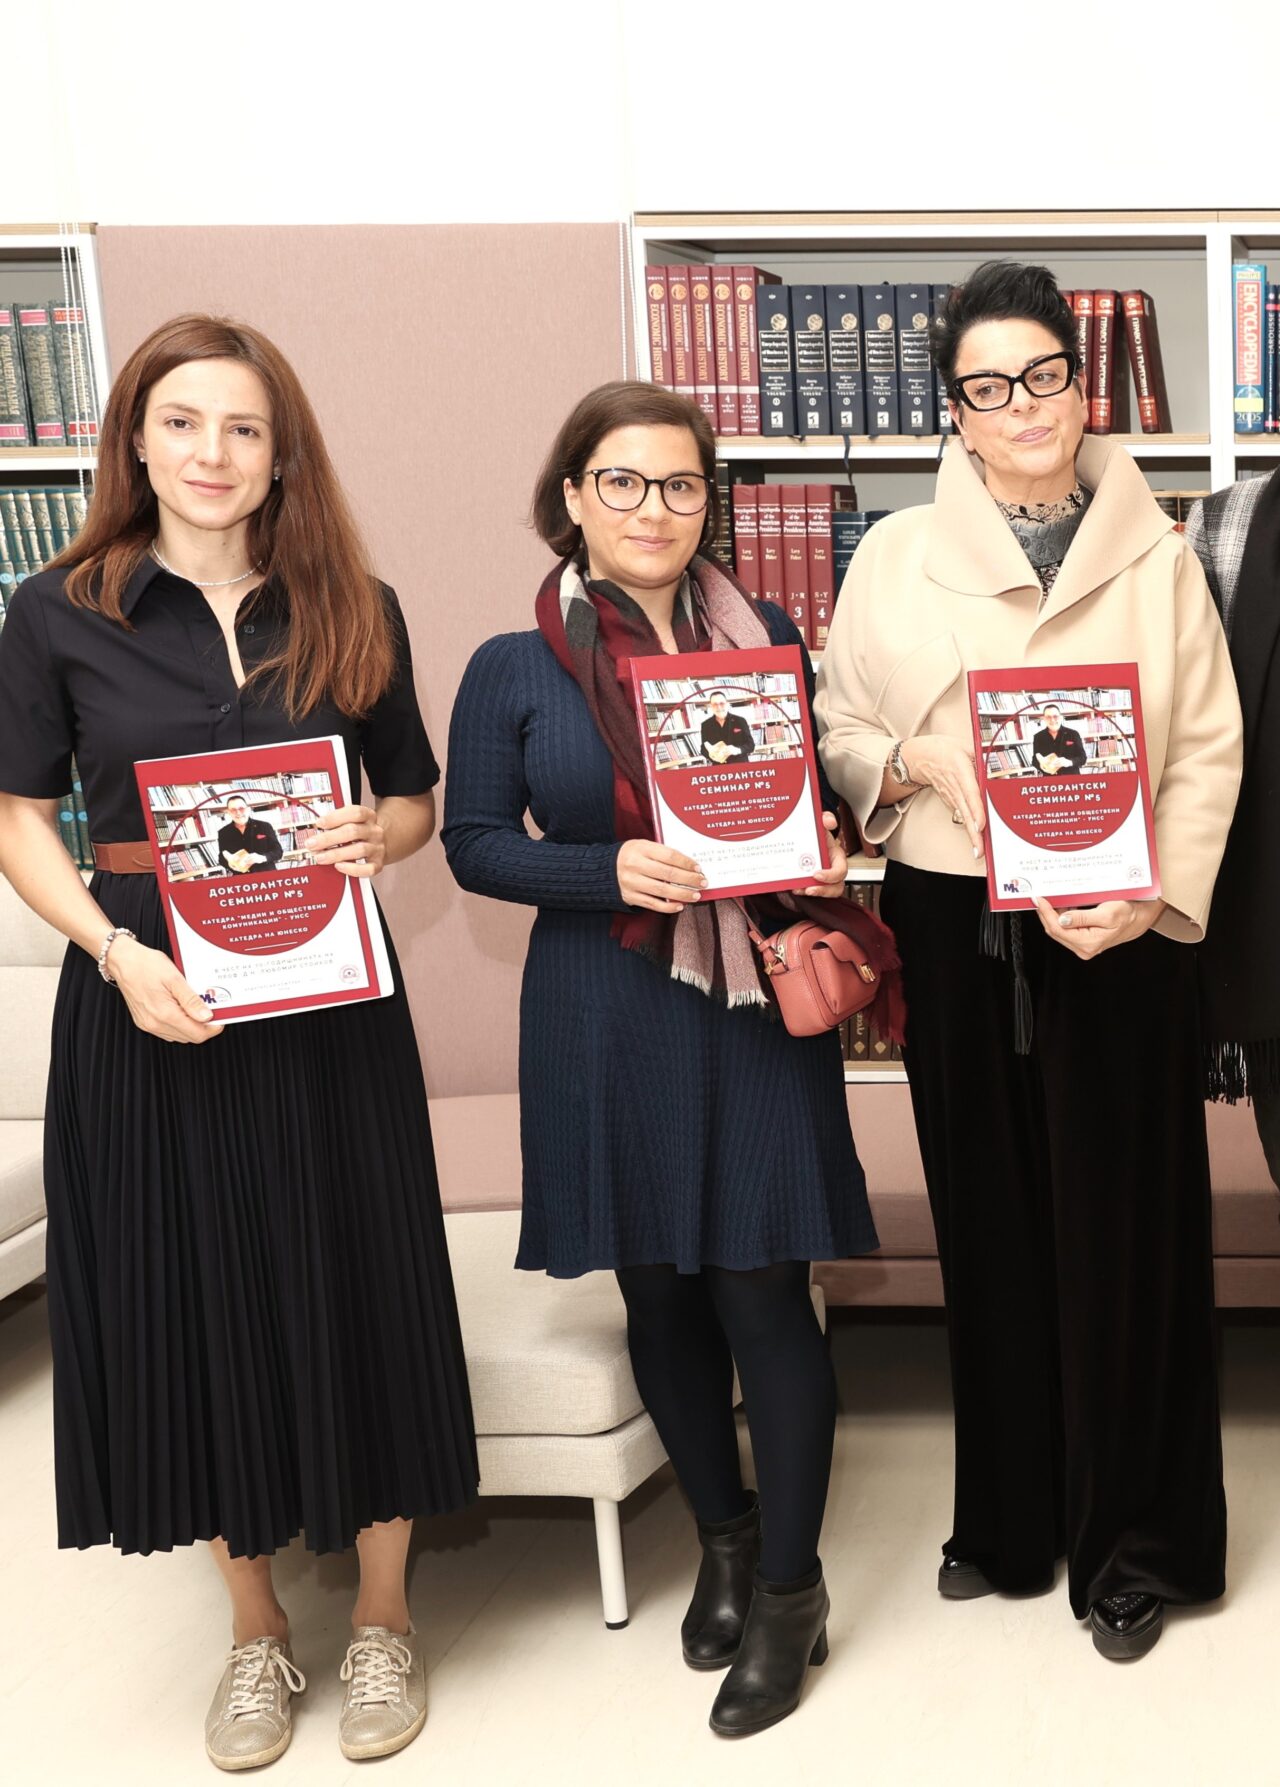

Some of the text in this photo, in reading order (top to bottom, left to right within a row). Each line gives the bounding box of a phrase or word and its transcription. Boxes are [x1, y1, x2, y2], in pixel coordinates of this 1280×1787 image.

[650, 304, 662, 346] ECONOMIC
[1100, 317, 1108, 343] ПРАВО
[1132, 317, 1141, 344] ПРАВО
[1243, 284, 1258, 382] ENCYCLOPEDIA
[673, 304, 686, 382] ECONOMIC HISTORY
[694, 304, 708, 382] ECONOMIC HISTORY
[715, 304, 728, 382] ECONOMIC HISTORY
[738, 304, 750, 382] ECONOMIC HISTORY
[653, 347, 664, 382] HISTORY
[794, 607, 802, 618] 3
[818, 607, 826, 618] 4
[691, 768, 775, 784] ДОКТОРАНТСКИ
[700, 782, 750, 794] СЕМИНАР
[1021, 781, 1106, 794] ДОКТОРАНТСКИ
[1029, 794, 1080, 804] СЕМИНАР
[208, 875, 309, 897] ДОКТОРАНТСКИ
[219, 892, 279, 907] СЕМИНАР
